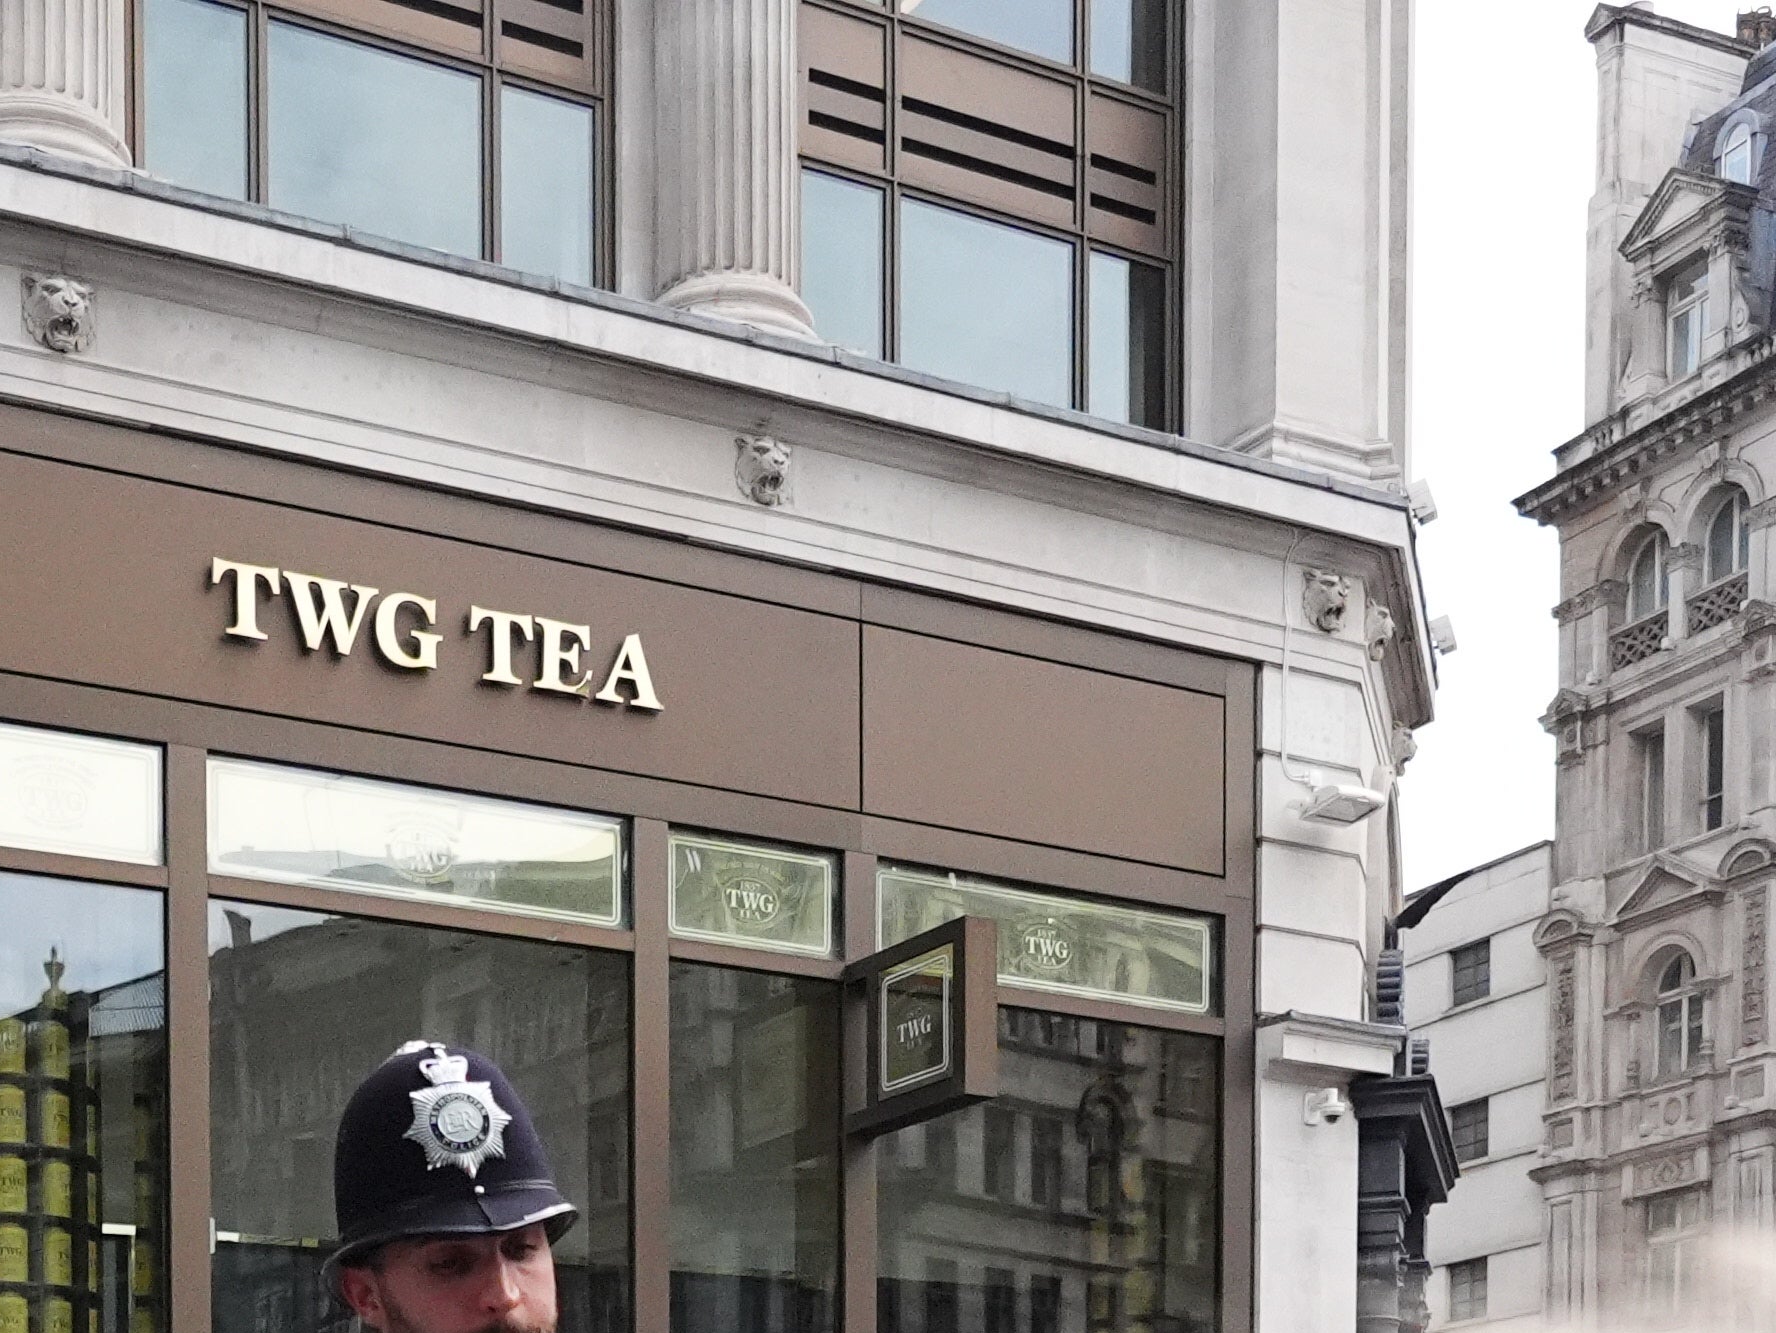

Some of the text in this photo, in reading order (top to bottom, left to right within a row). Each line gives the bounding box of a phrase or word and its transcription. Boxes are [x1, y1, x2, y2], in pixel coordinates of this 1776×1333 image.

[209, 555, 665, 713] TWG TEA
[726, 888, 774, 913] TWG
[1025, 936, 1068, 959] TWG
[896, 1014, 932, 1043] TWG
